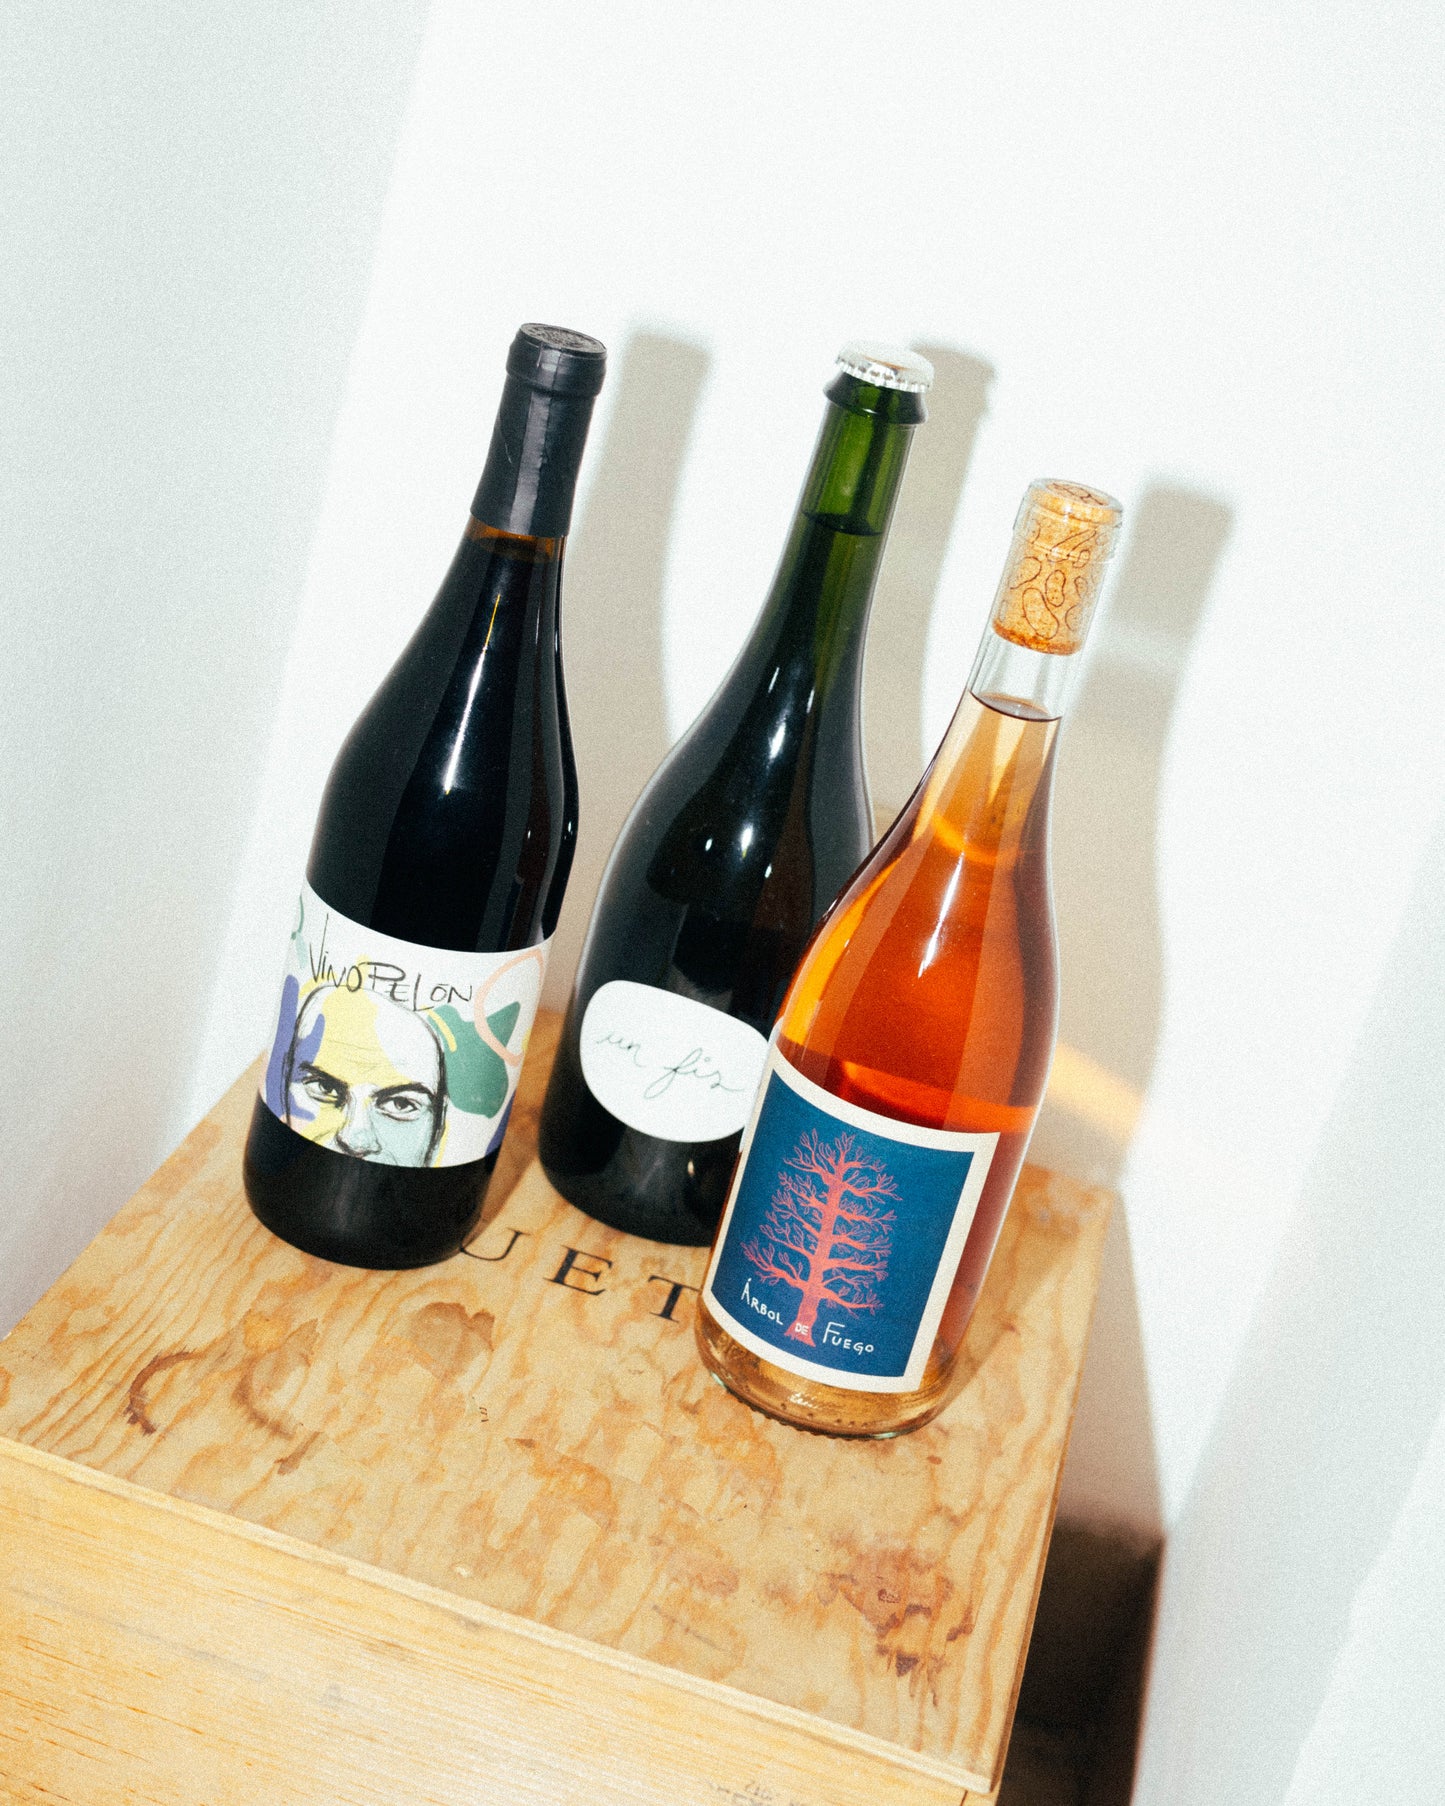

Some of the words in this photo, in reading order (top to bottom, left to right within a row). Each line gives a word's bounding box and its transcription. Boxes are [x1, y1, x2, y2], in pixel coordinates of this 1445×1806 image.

[740, 1277, 784, 1326] ÁRBOL
[793, 1322, 810, 1336] DE
[822, 1320, 875, 1356] FUEGO
